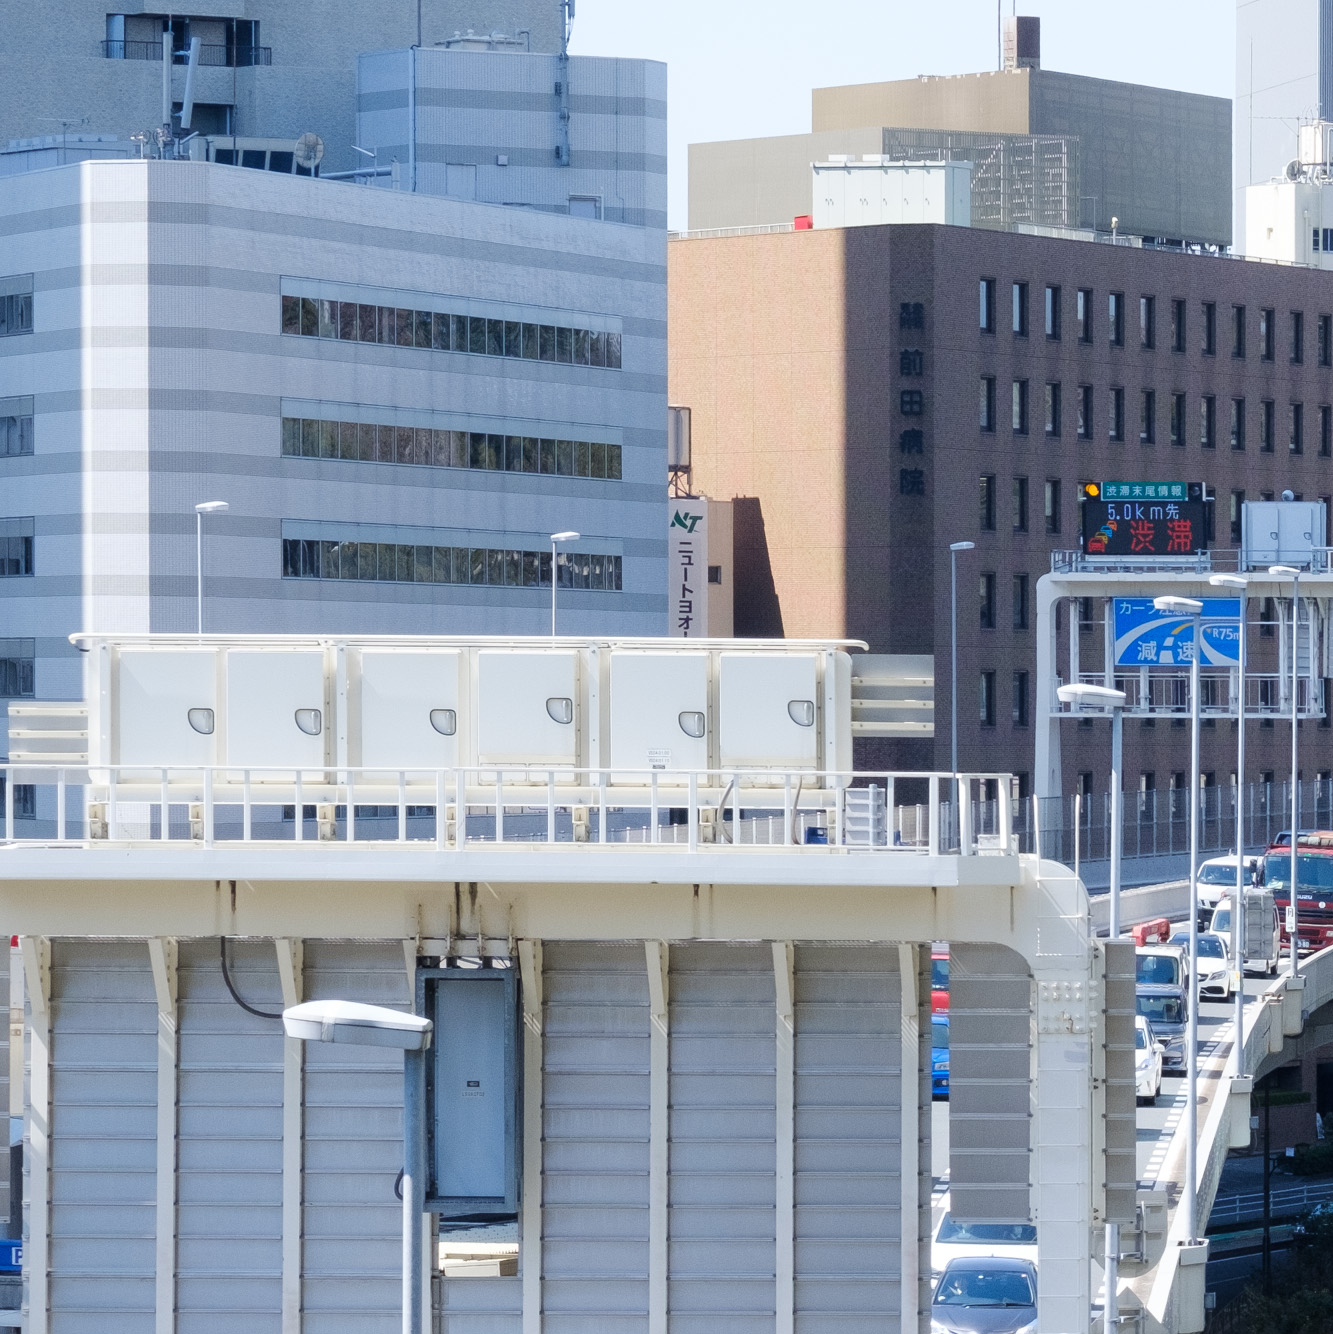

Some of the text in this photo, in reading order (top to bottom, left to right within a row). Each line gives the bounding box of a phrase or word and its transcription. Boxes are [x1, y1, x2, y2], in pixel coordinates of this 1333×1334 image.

[1106, 485, 1182, 497] 渋滞末尾情報
